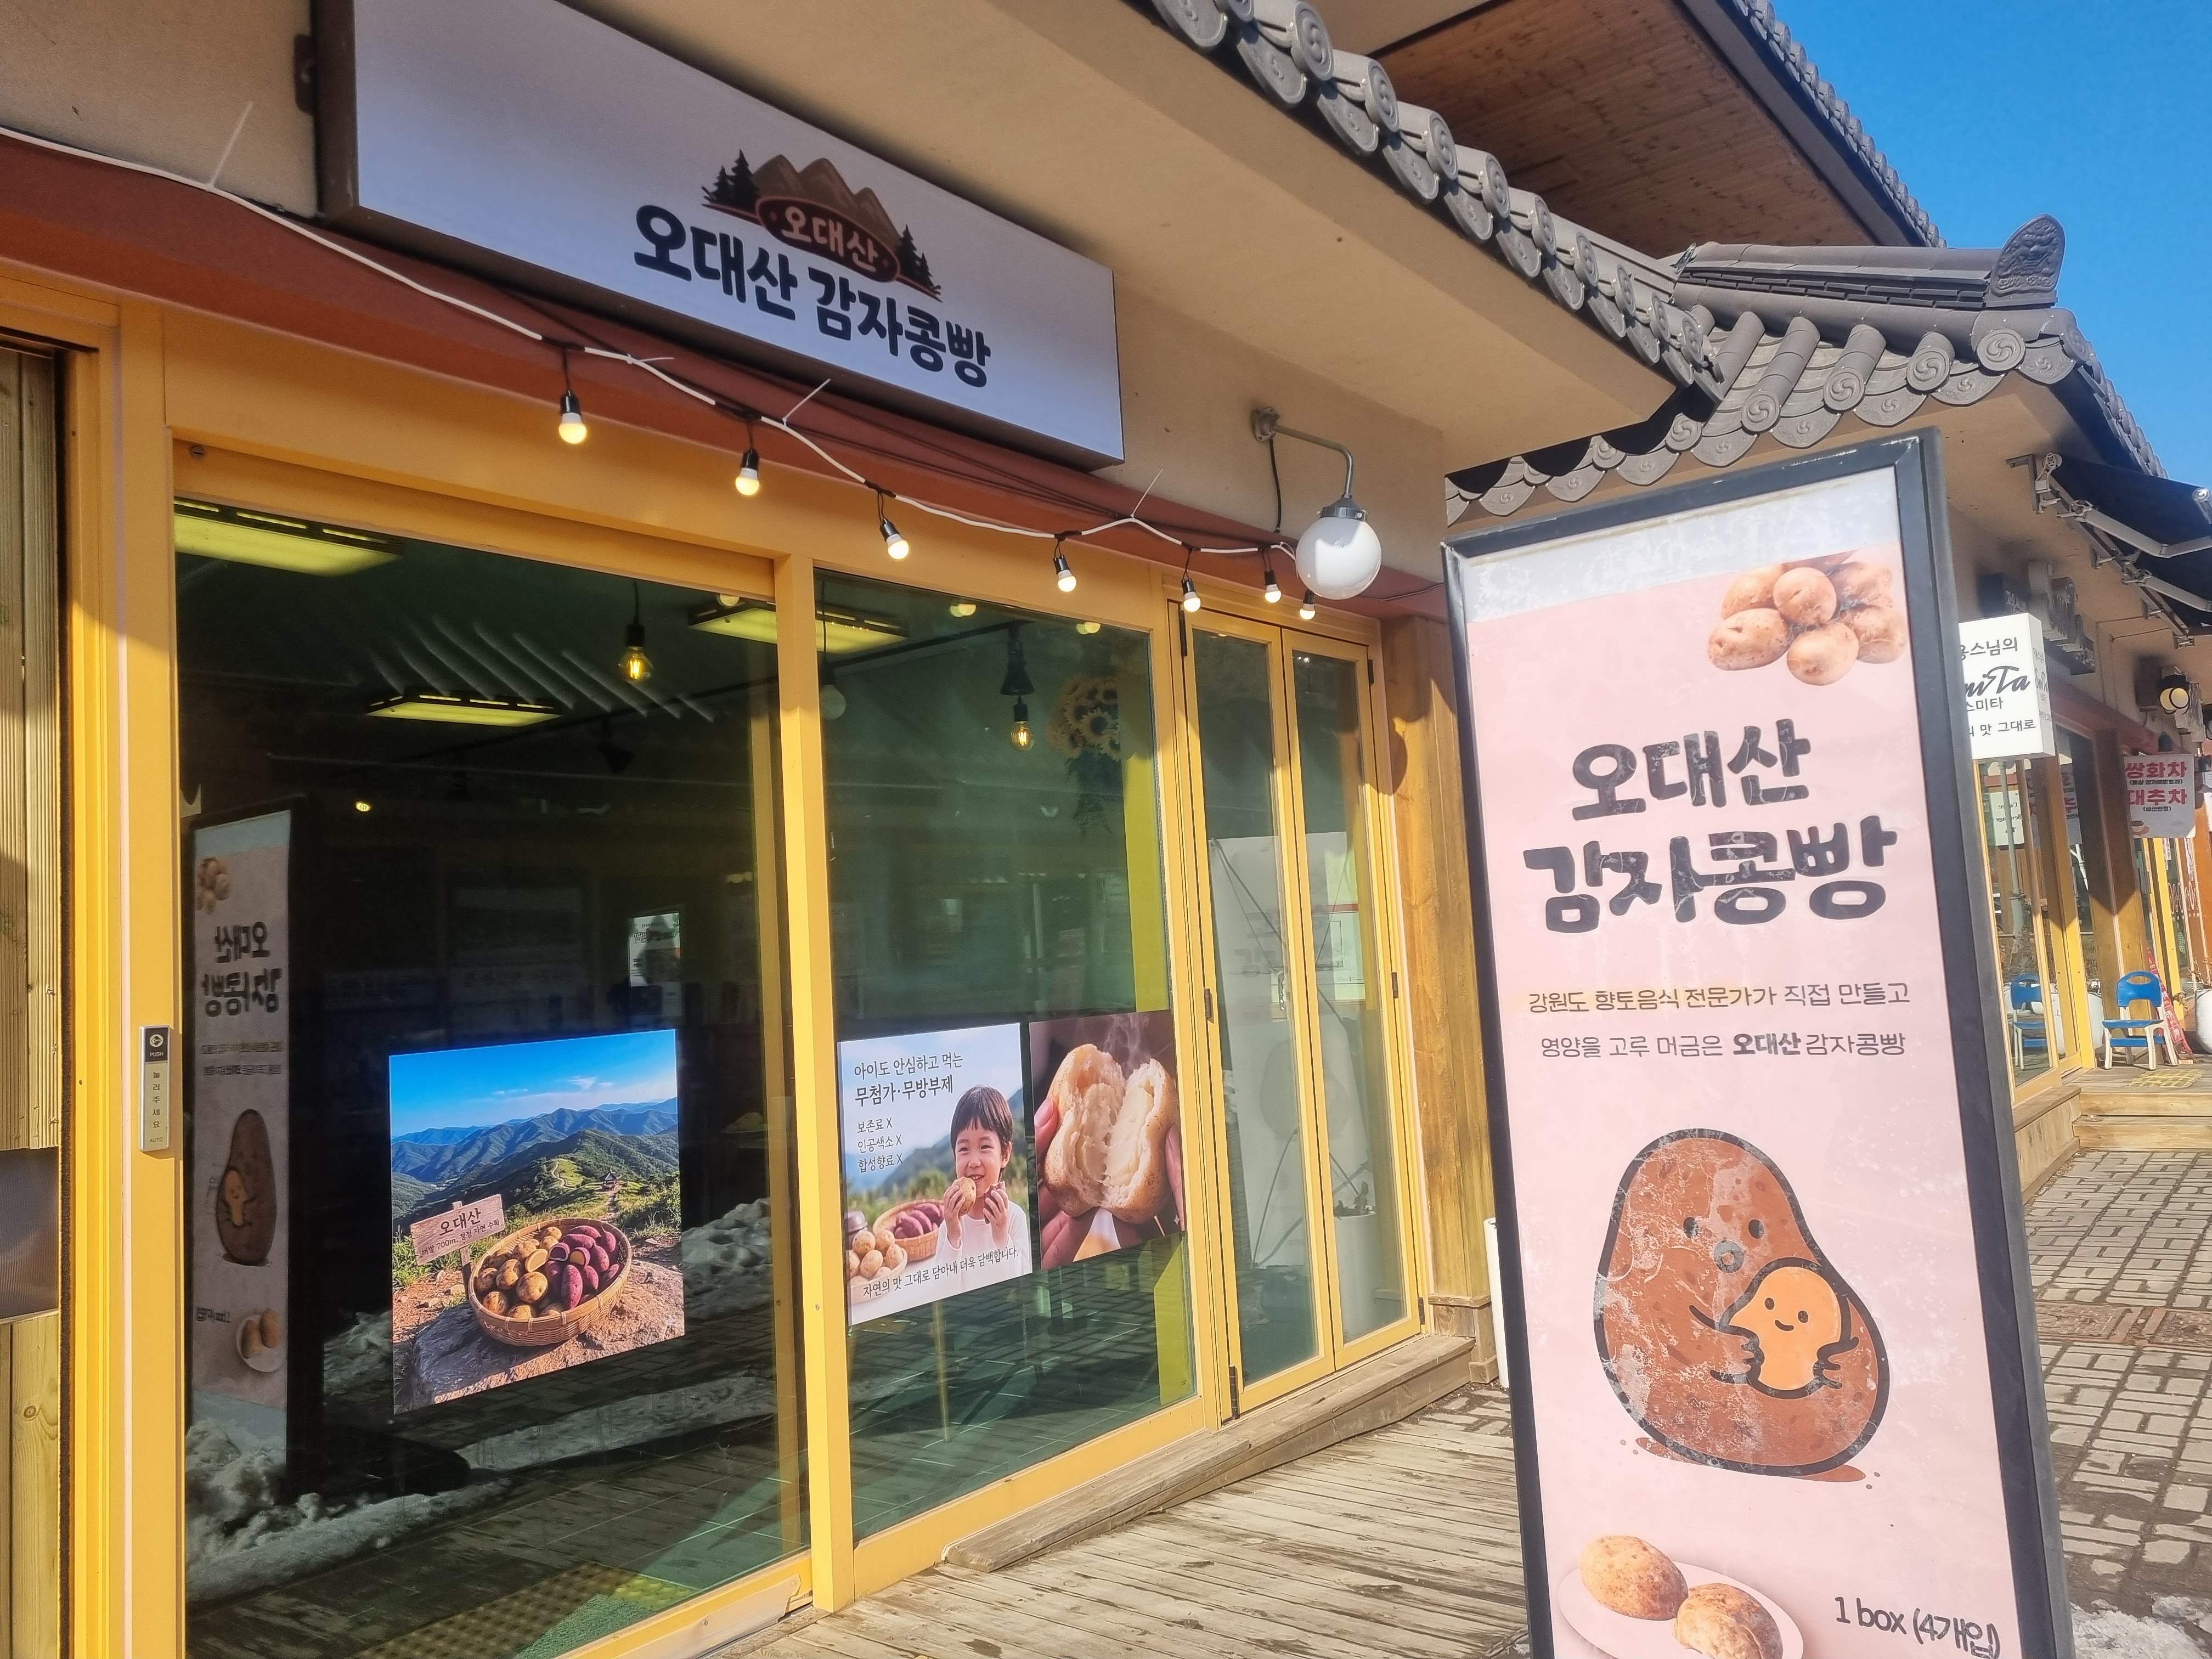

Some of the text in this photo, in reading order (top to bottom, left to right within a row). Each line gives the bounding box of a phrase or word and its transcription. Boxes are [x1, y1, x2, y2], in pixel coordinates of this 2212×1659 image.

[782, 206, 878, 273] 오대산
[634, 205, 991, 387] 오대산 감자콩빵
[1980, 724, 1992, 736] 맛
[1997, 719, 2036, 732] 그대로
[1572, 719, 1811, 820] 오대산
[2125, 761, 2187, 778] 쌍화차
[2128, 788, 2187, 805] 대추차
[1523, 815, 1898, 934] 감자콩빵
[1529, 983, 1910, 1013] 강원도 향토음식 전문가가 직접 만들고
[1541, 1032, 1906, 1058] 영양을 고루 머금은 오대산 감자콩빵
[854, 1052, 963, 1081] 아이도 안심하고 먹는
[857, 1117, 893, 1133] 보존료 X
[857, 1135, 902, 1153] 인공색소 X
[857, 1153, 904, 1173] 합성향료 X
[439, 1207, 481, 1236] 오대산
[436, 1238, 459, 1250] 700m,
[473, 1224, 486, 1235] 자연
[863, 1245, 1019, 1298] 자연의 맛 그대로 담아내 더욱 담백합니다.
[1834, 1596, 1851, 1624] 1
[1857, 1598, 1907, 1635] box
